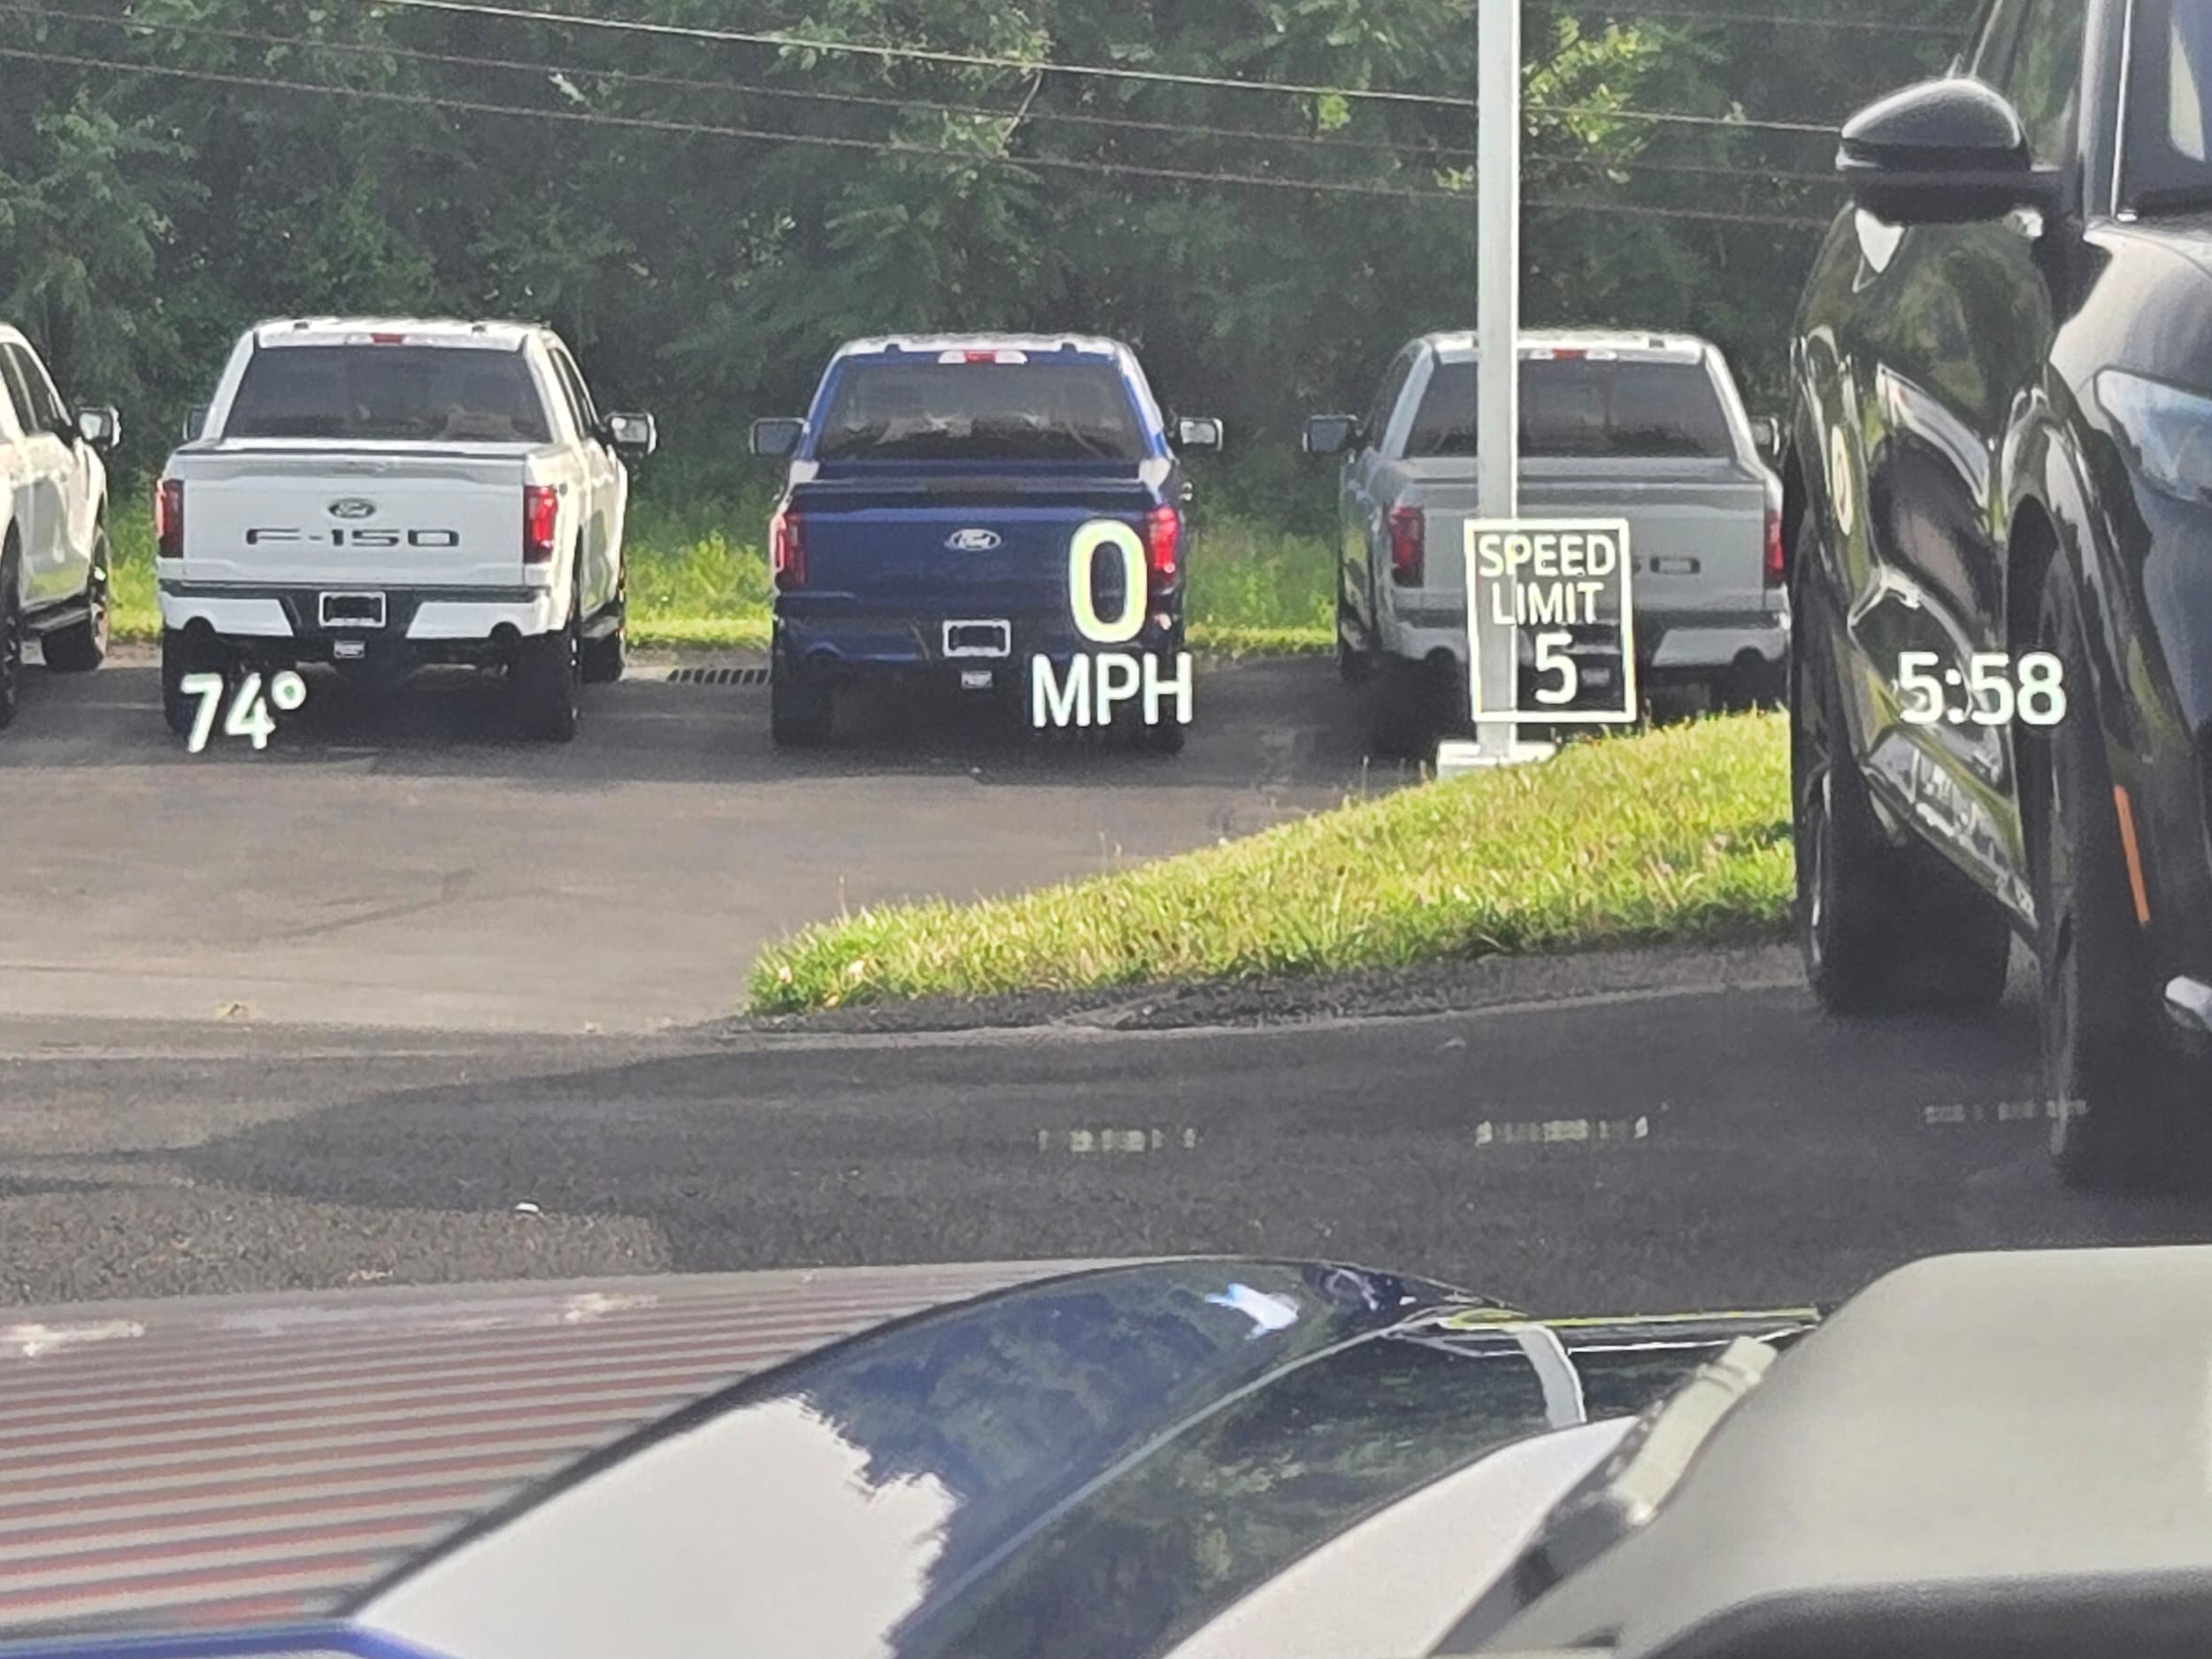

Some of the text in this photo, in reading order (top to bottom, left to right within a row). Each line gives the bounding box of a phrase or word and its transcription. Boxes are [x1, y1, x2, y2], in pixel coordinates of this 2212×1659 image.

[246, 528, 459, 547] F-150
[1479, 534, 1617, 577] SPEED
[1068, 519, 1148, 643] 0
[1492, 581, 1605, 625] LIMIT
[1032, 651, 1193, 727] MPH
[1535, 631, 1578, 704] 5
[1898, 651, 2067, 726] 5:58
[180, 671, 306, 753] 74°
